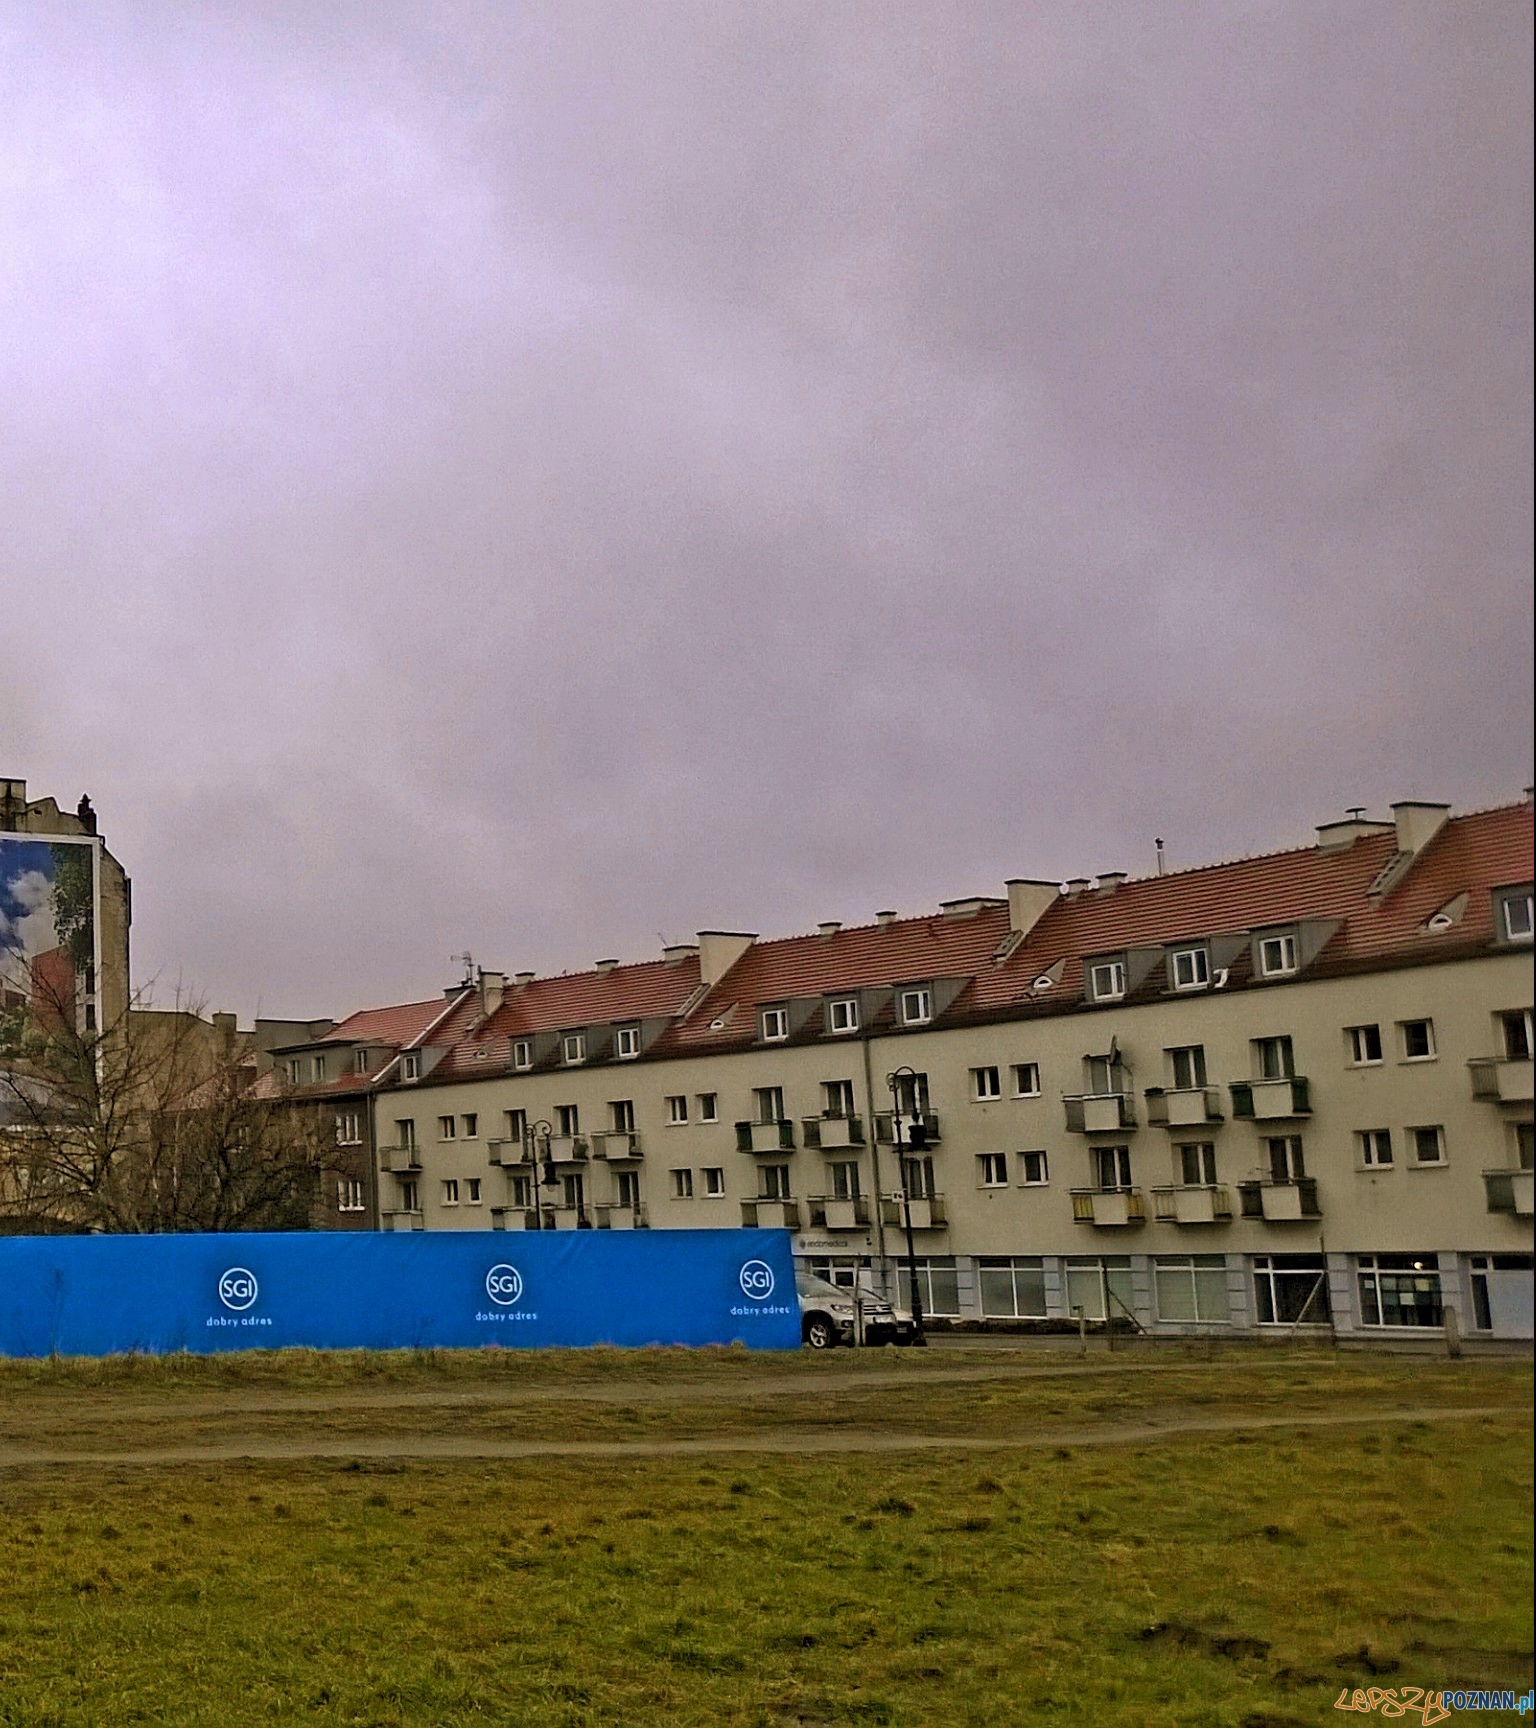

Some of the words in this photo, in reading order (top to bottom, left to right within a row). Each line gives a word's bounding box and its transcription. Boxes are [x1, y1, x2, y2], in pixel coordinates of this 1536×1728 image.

[490, 1275, 517, 1293] SGI
[743, 1271, 770, 1288] SGI
[223, 1279, 252, 1297] SGI
[475, 1311, 505, 1322] dobry
[508, 1311, 537, 1320] adres
[730, 1306, 759, 1316] dobry
[762, 1305, 790, 1314] adres
[206, 1316, 238, 1327] dobry
[241, 1316, 272, 1325] adres
